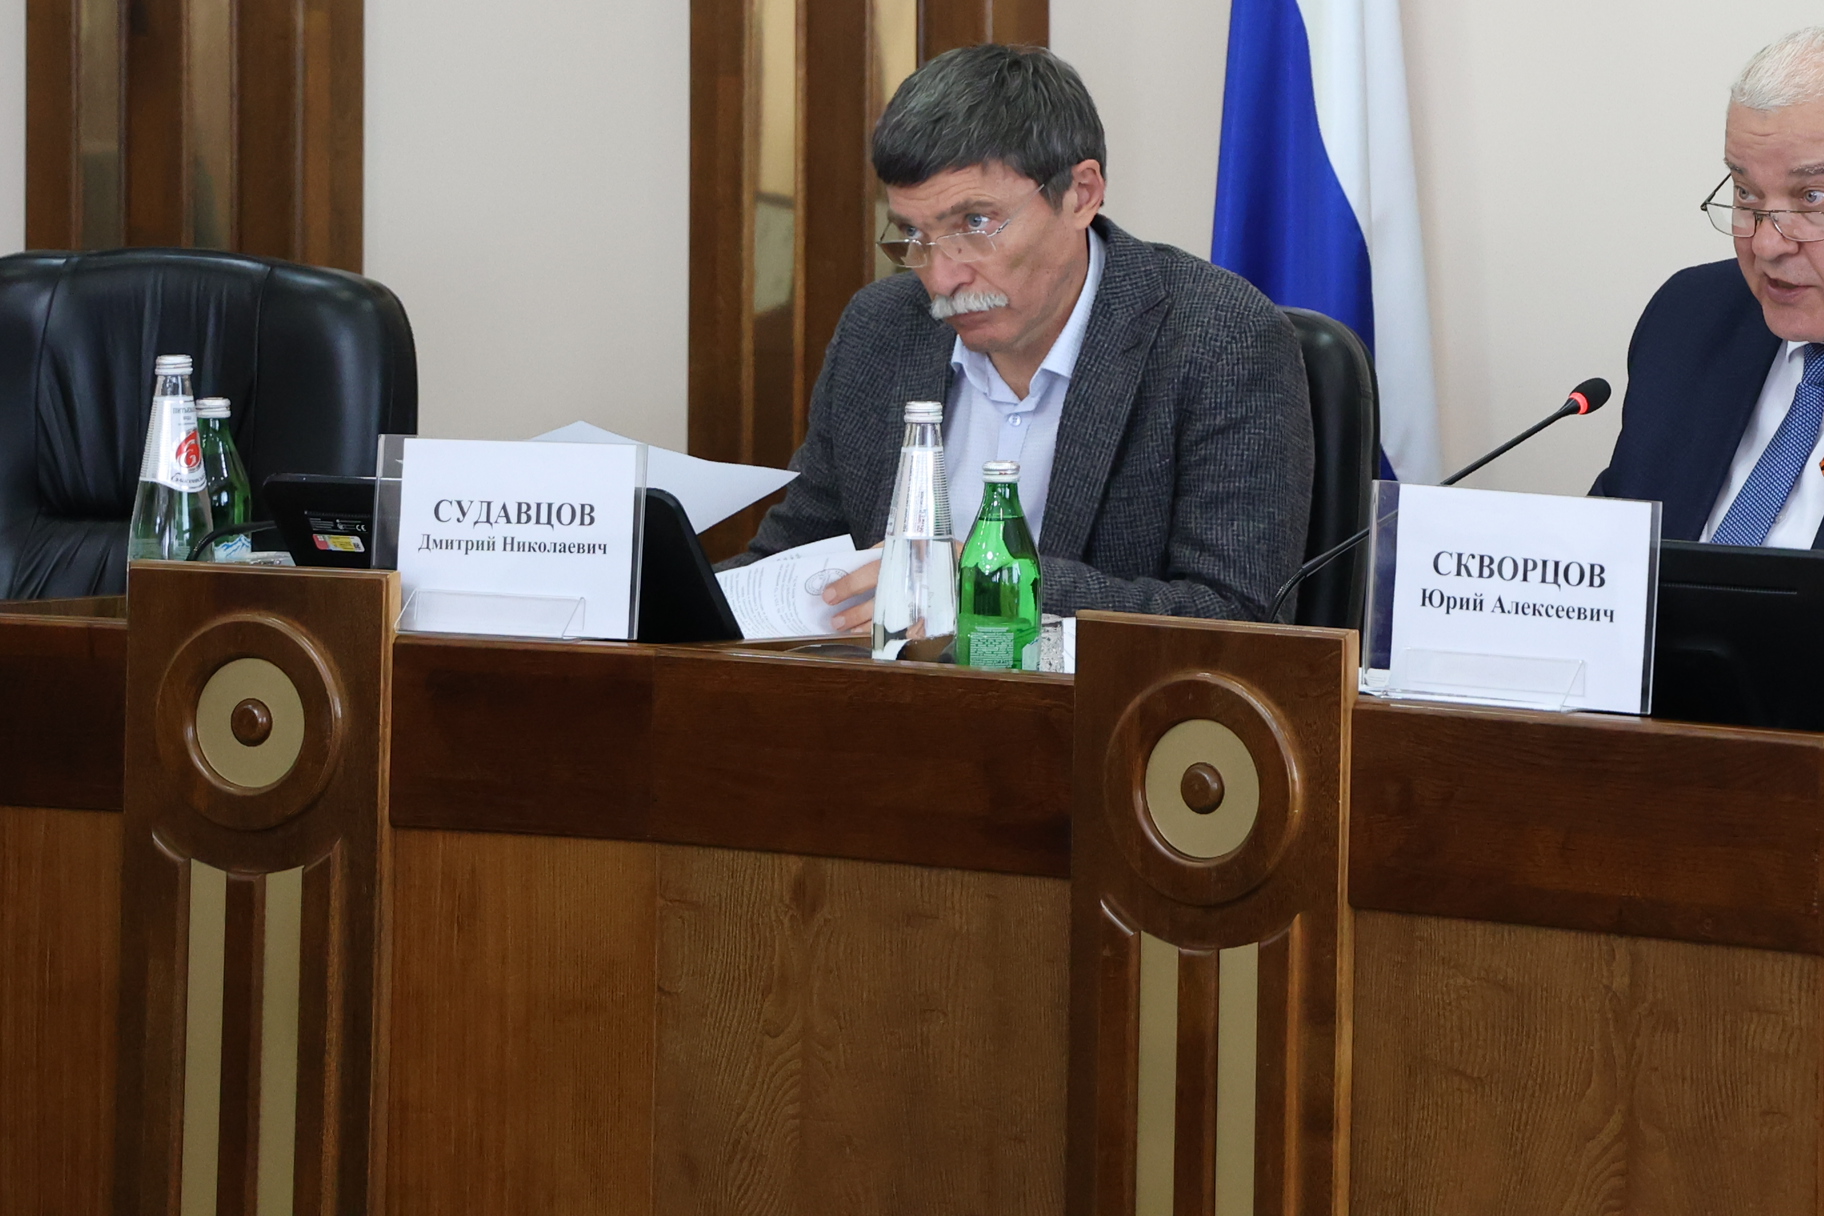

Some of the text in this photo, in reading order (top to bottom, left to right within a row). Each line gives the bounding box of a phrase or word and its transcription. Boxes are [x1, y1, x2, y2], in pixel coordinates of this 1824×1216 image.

[433, 498, 596, 531] СУДАВЦОВ
[417, 533, 608, 556] Дмитрий Николаевич
[1432, 550, 1607, 592] СКВОРЦОВ
[1420, 587, 1616, 624] Юрий Алексеевич
